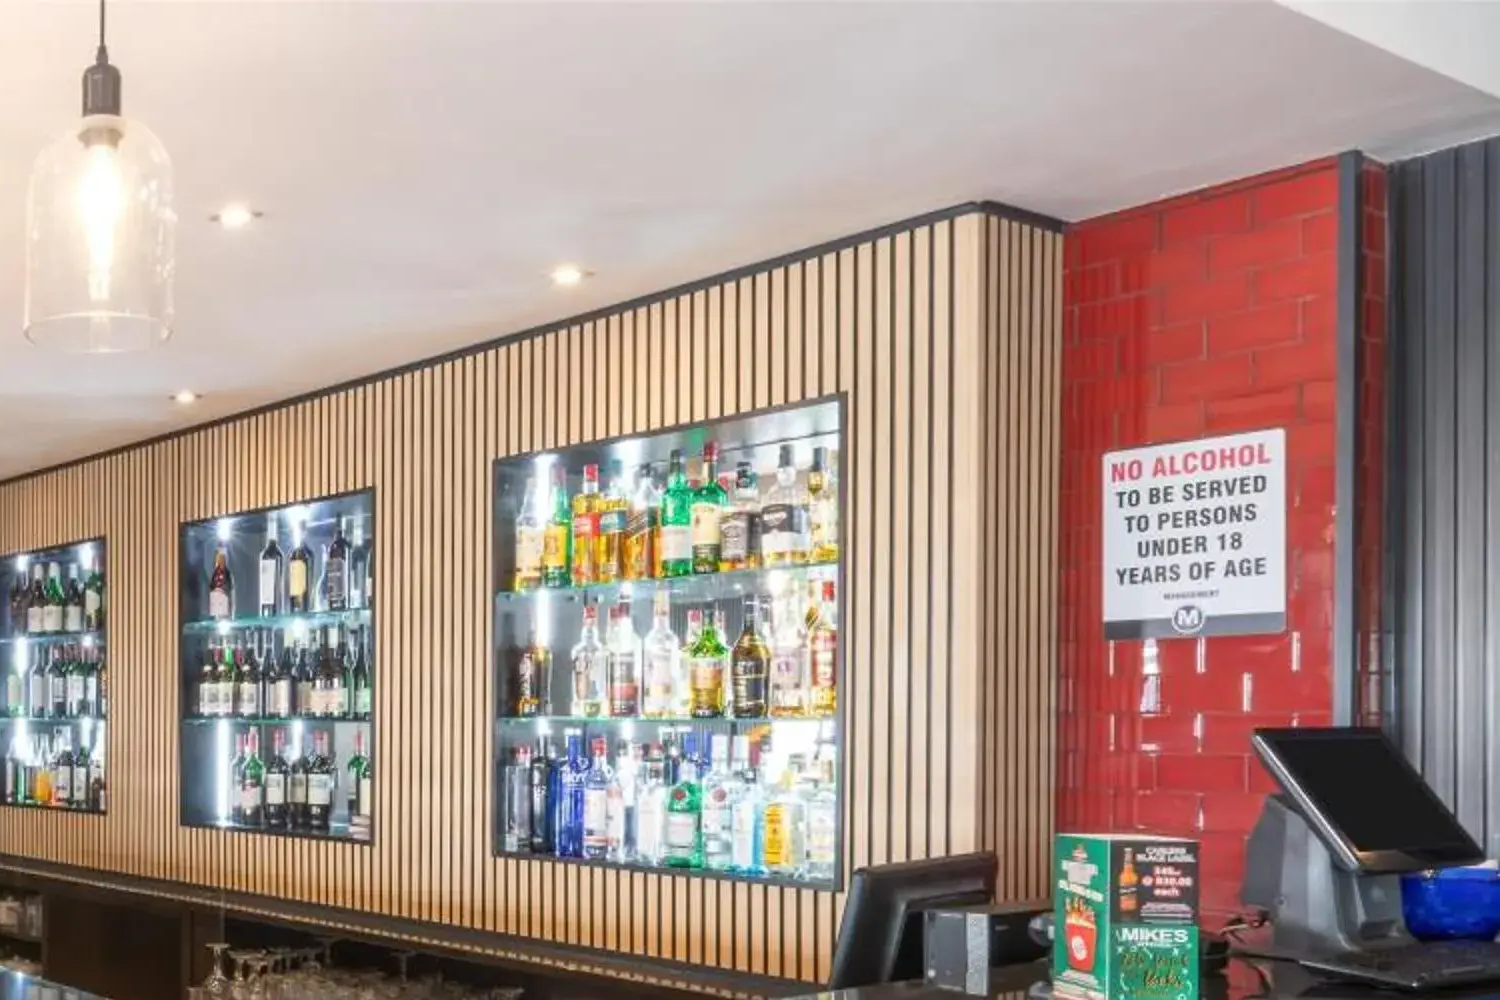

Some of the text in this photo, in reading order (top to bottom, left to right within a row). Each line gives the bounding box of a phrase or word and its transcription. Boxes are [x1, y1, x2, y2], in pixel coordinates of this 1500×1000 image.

[1111, 443, 1271, 482] NO ALCOHOL
[1115, 475, 1267, 508] TO BE SERVED
[1125, 503, 1257, 534] TO PERSONS
[1137, 532, 1243, 558] UNDER 18
[1116, 557, 1267, 586] YEARS OF AGE
[1177, 609, 1199, 625] M
[1153, 887, 1181, 897] each
[1121, 927, 1189, 943] MIKES
